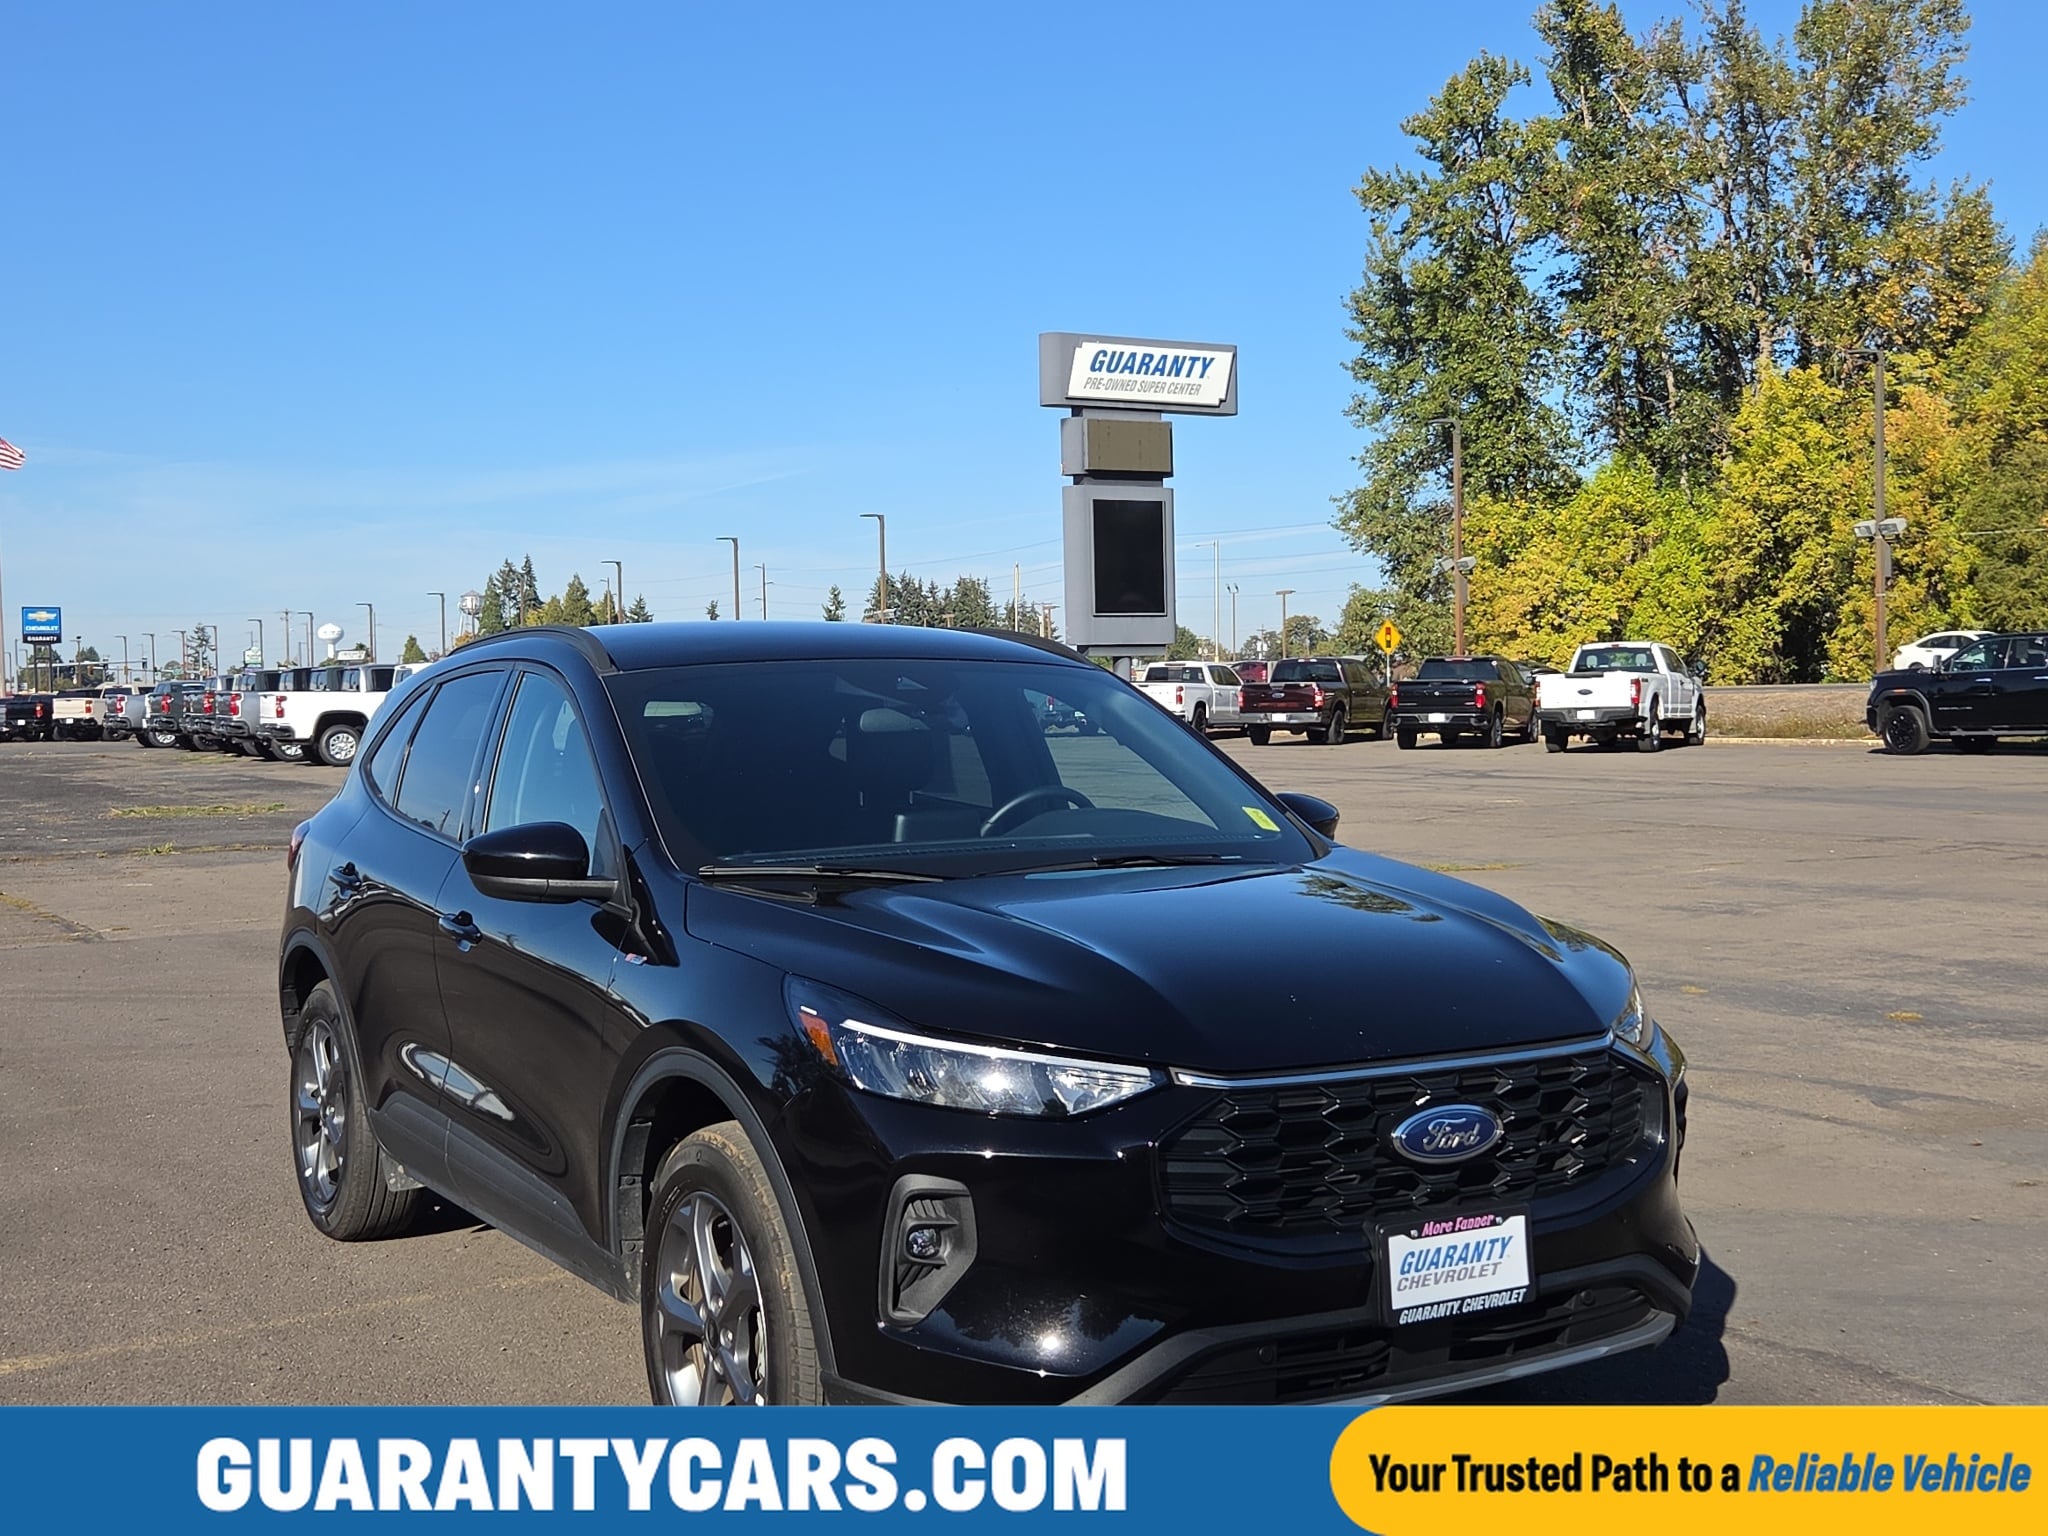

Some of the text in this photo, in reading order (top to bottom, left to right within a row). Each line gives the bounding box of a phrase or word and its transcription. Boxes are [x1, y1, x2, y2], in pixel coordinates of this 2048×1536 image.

[1090, 349, 1215, 379] GUARANTY
[1083, 377, 1202, 396] PRE-OWNED SUPER CENTER
[1422, 1117, 1480, 1151] Ford
[1421, 1220, 1453, 1237] More
[1399, 1235, 1513, 1276] GUARANTY
[1396, 1261, 1502, 1292] CHEVROLET
[1462, 1288, 1526, 1312] CHEVROLET
